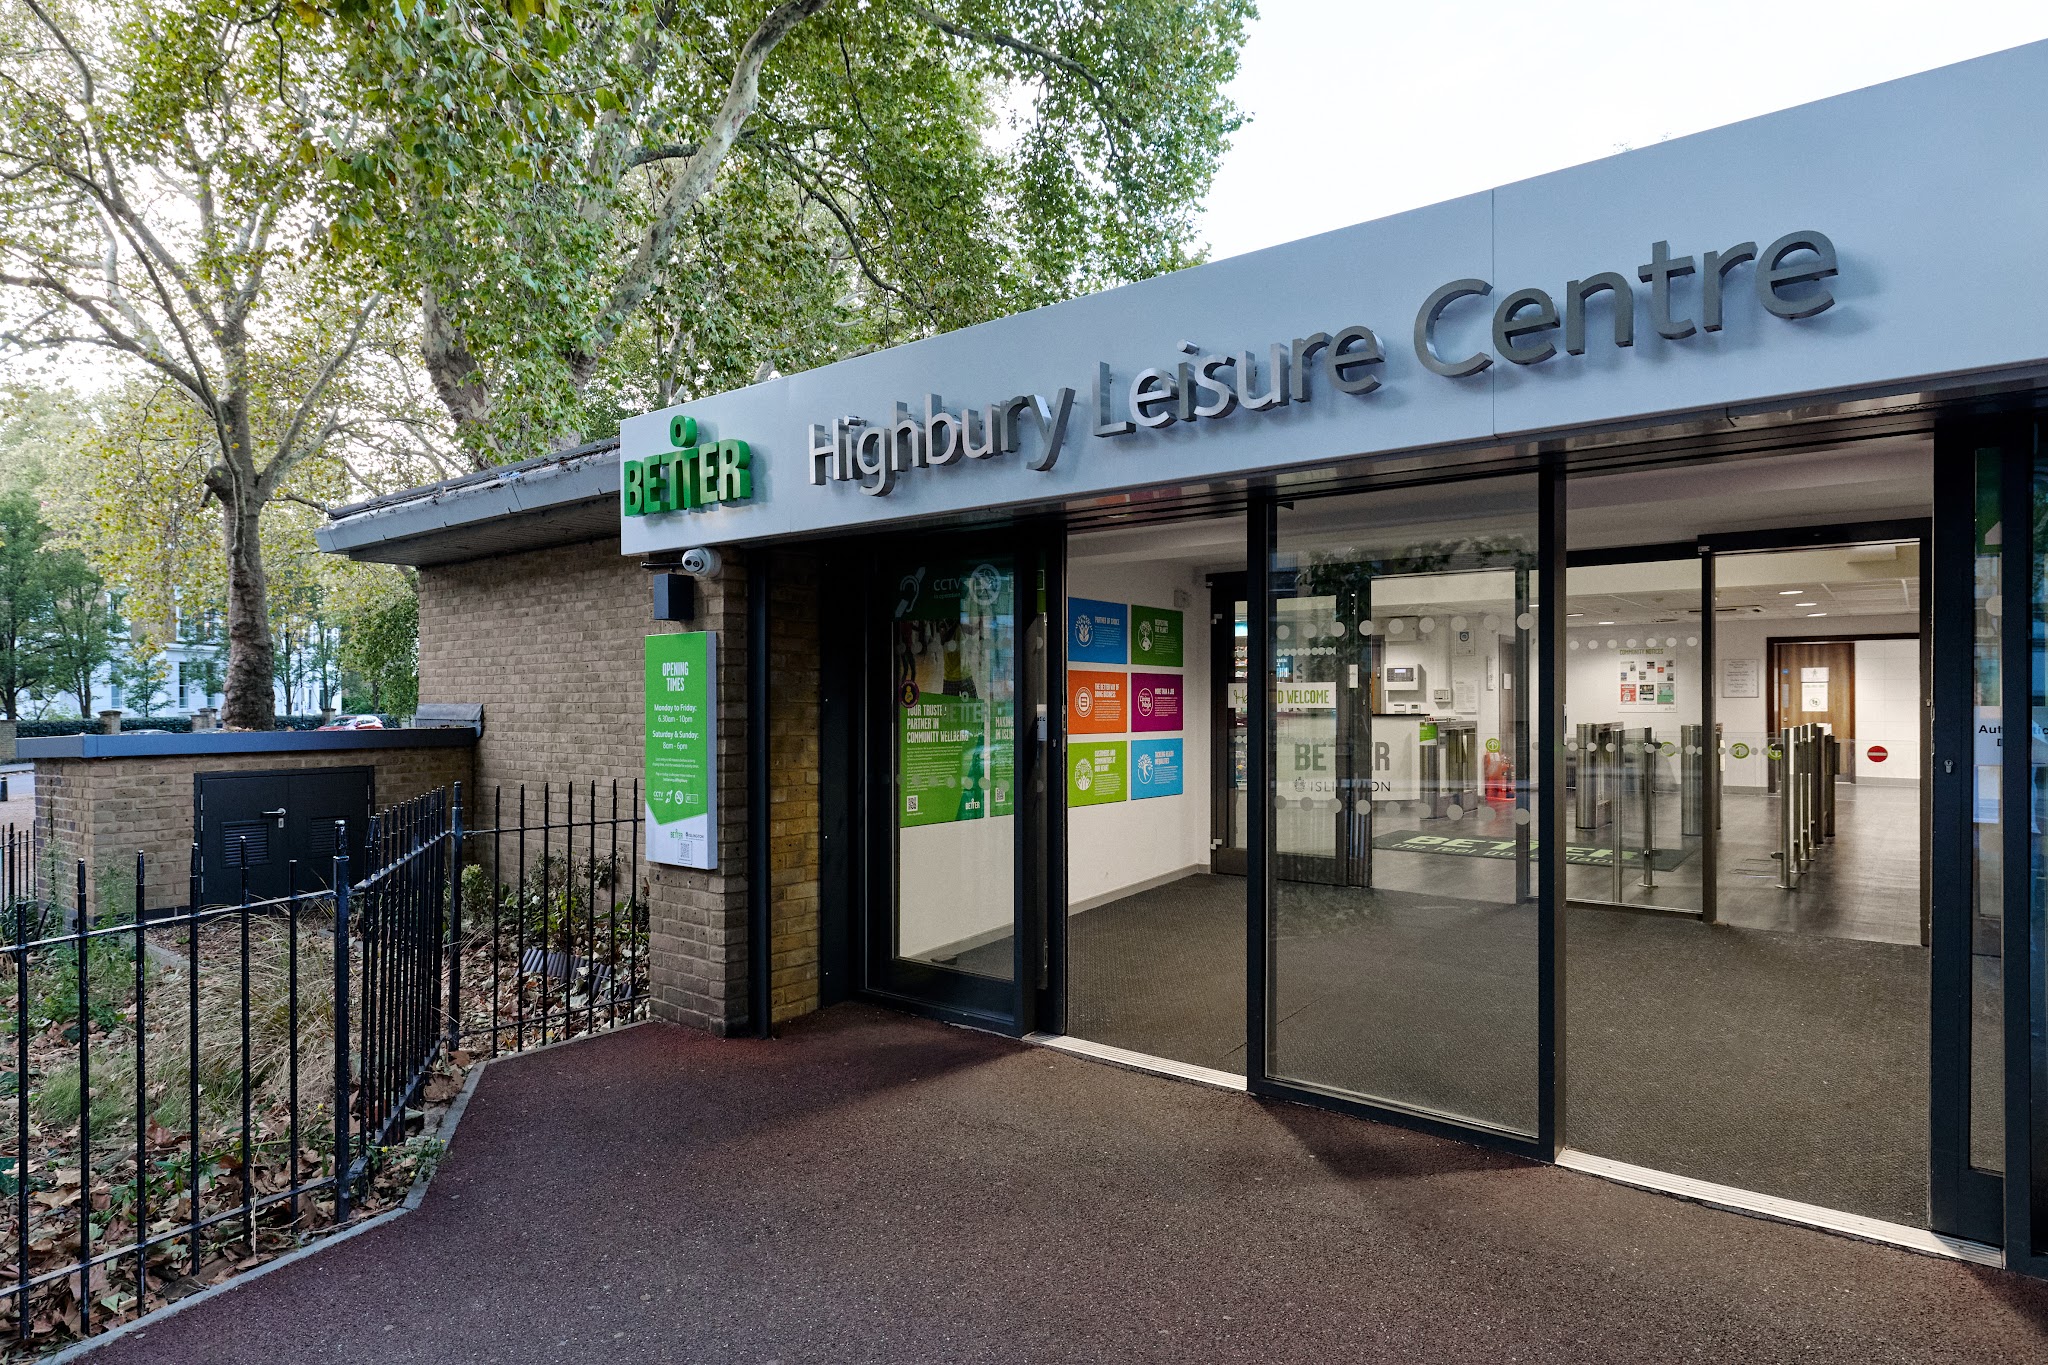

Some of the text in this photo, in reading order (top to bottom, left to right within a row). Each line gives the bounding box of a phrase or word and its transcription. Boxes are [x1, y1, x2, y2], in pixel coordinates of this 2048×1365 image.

[809, 230, 1839, 498] Highbury Leisure Centre
[624, 438, 753, 518] BETTER
[933, 577, 961, 591] CCTV
[1619, 648, 1645, 656] COMMUNITY
[662, 662, 689, 677] OPENING
[666, 677, 685, 692] TIMES
[1287, 689, 1330, 704] WELCOME
[654, 704, 673, 713] Monday
[679, 715, 693, 723] 10pm
[907, 717, 939, 730] PARTNER IN
[652, 730, 673, 740] Saturday
[907, 730, 969, 743] COMMUNITY WELLBEING
[677, 742, 687, 751] 6pm
[1294, 741, 1390, 771] BER
[1310, 780, 1391, 792] ISLION
